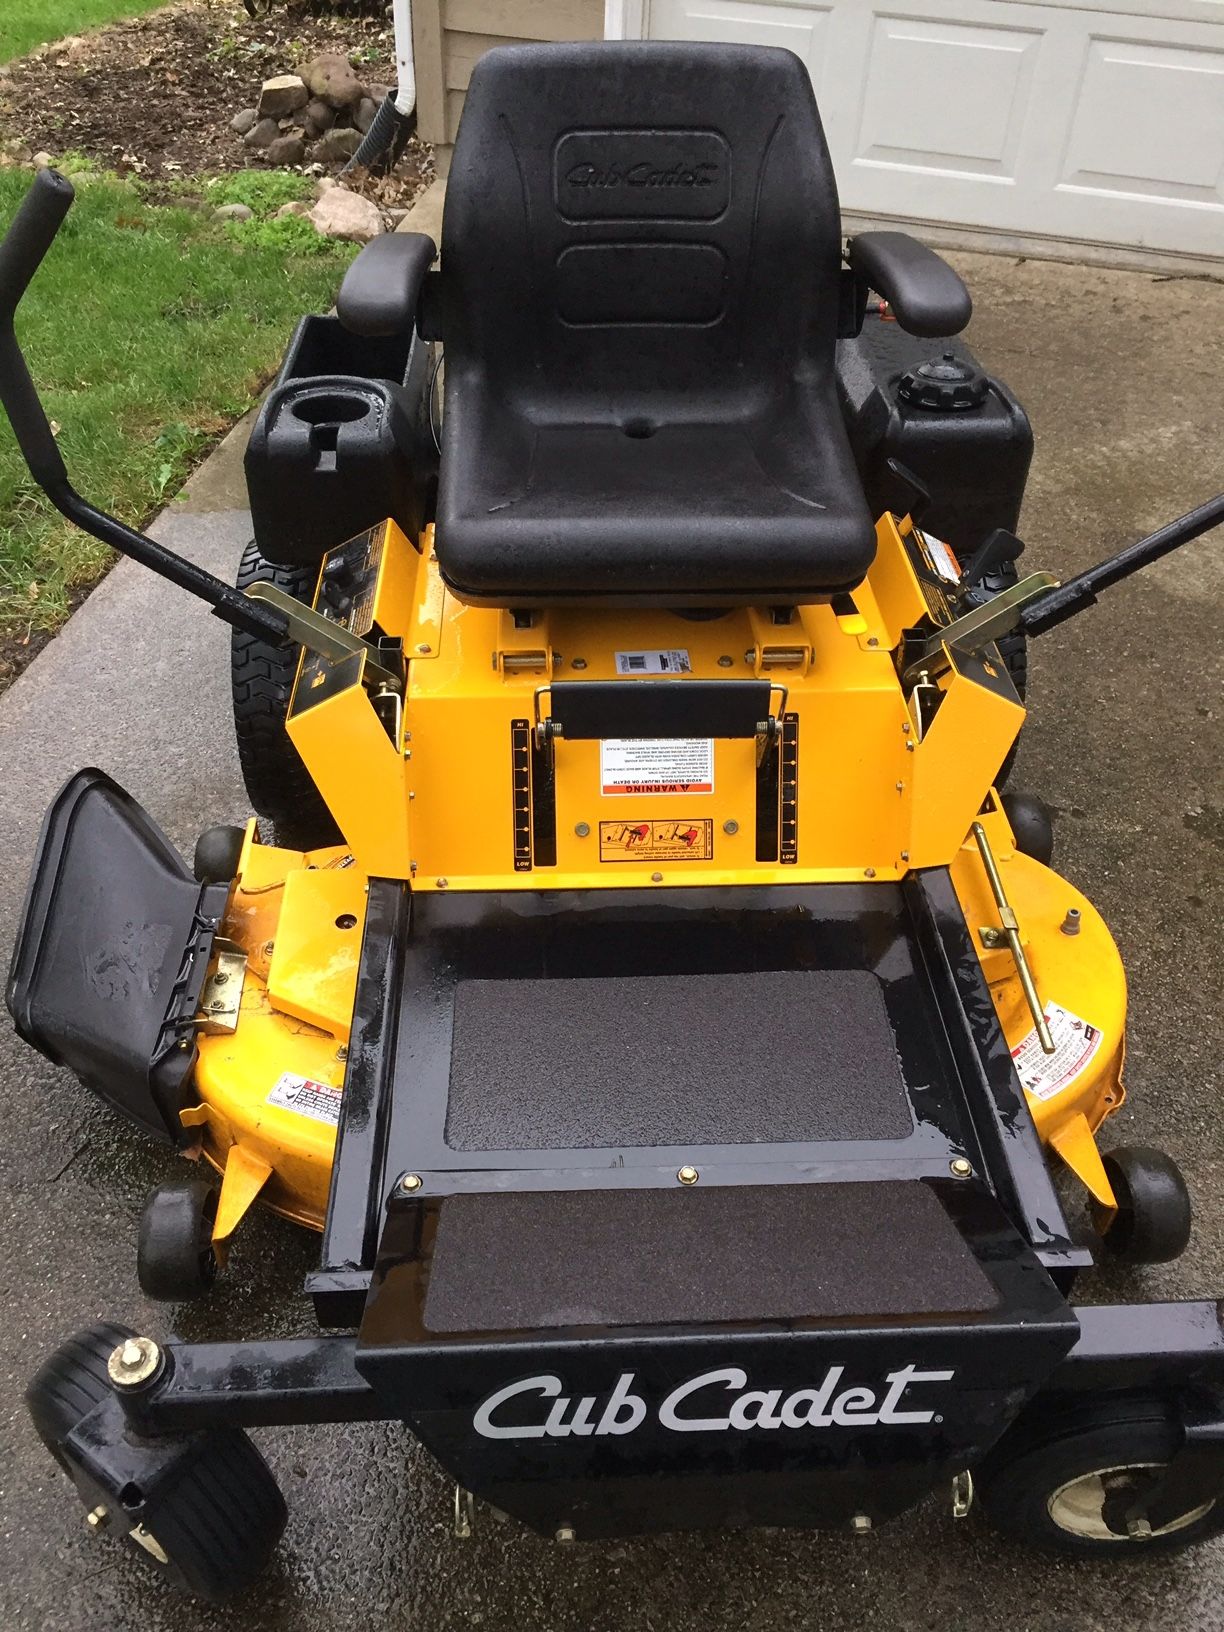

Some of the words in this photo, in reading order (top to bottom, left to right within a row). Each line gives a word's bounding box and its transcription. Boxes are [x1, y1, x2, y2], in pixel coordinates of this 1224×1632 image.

[566, 162, 621, 188] Cub
[626, 161, 719, 188] Cadet
[625, 784, 677, 793] WARNING
[320, 1085, 342, 1100] DANG
[473, 1373, 647, 1440] Cub
[658, 1364, 956, 1432] Cadet
